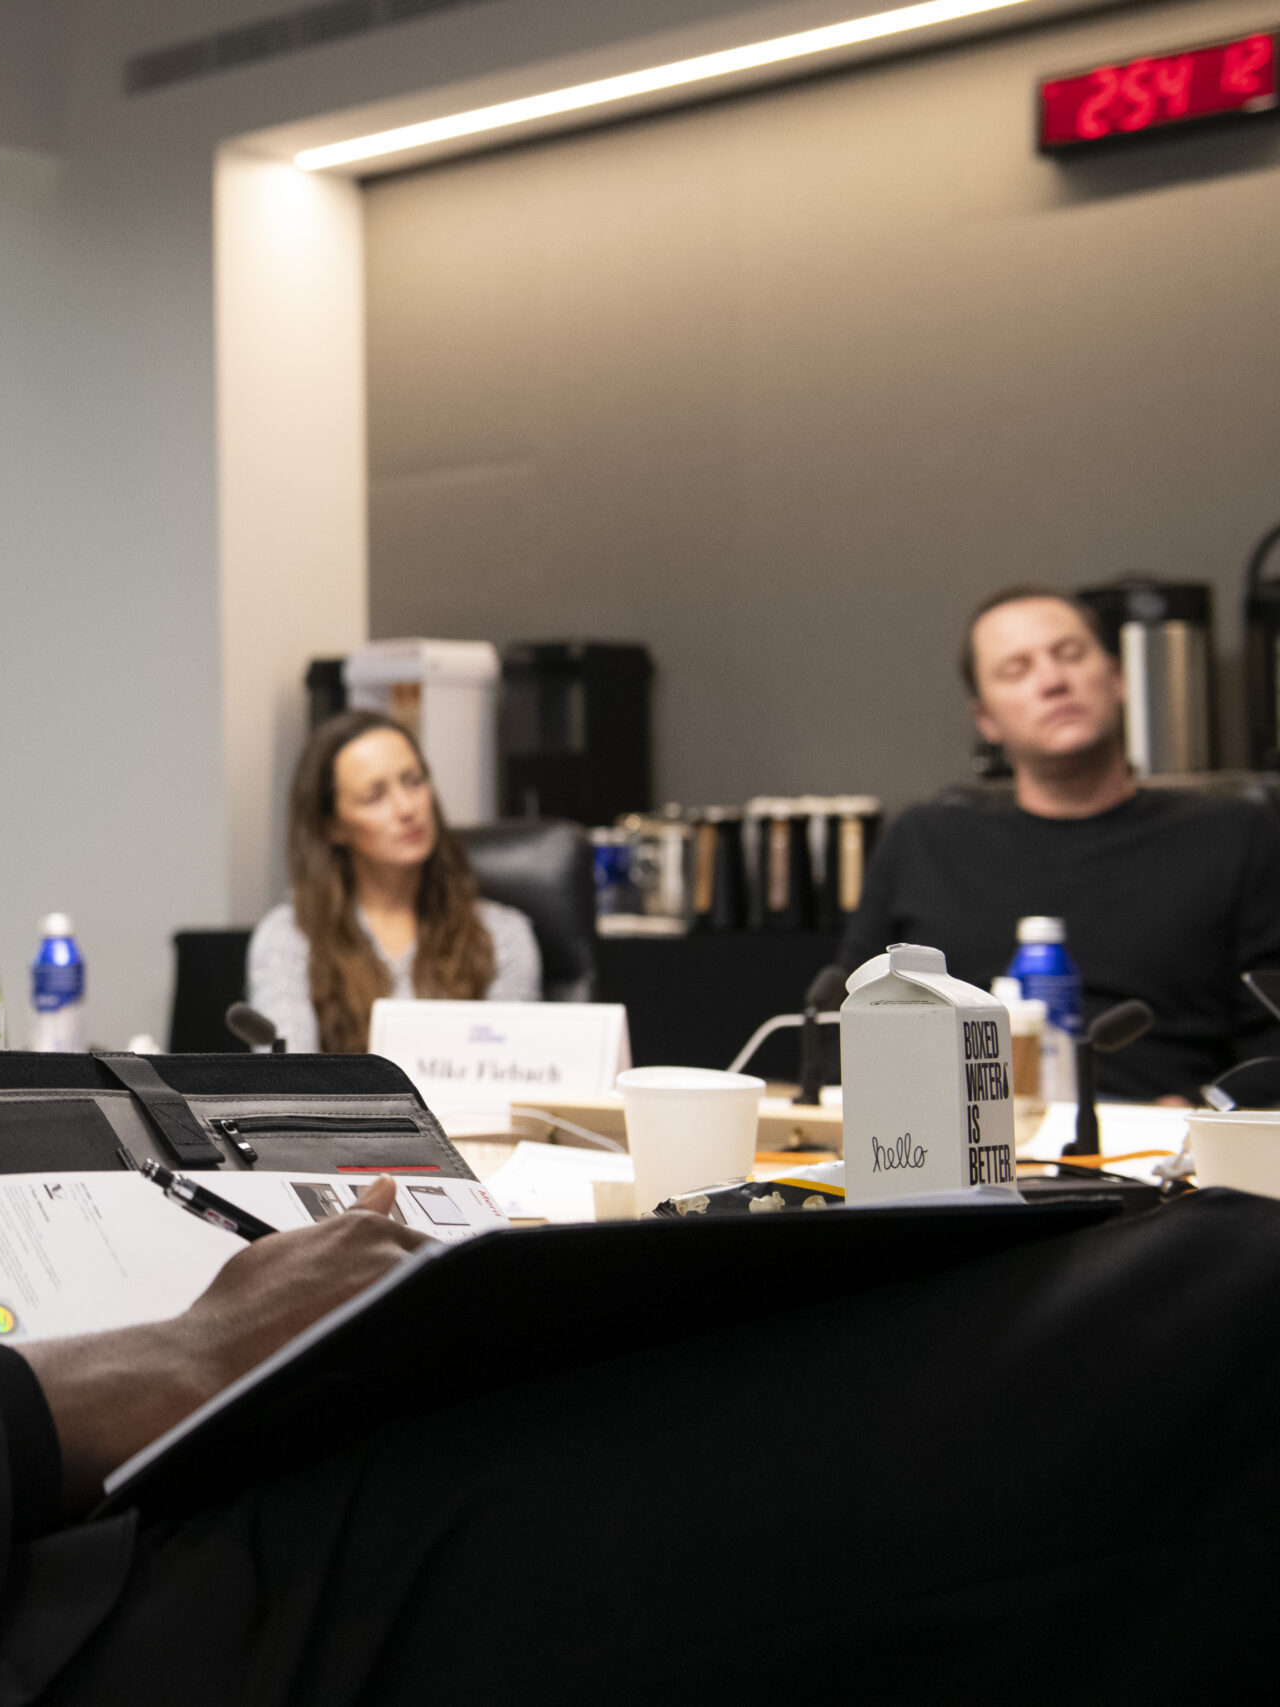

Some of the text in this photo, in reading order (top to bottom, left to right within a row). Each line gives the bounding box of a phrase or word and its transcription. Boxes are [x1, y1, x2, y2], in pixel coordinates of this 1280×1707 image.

[963, 1021, 999, 1059] BOXED
[965, 1062, 1002, 1101] WATER
[967, 1104, 981, 1143] IS
[872, 1132, 928, 1173] hello
